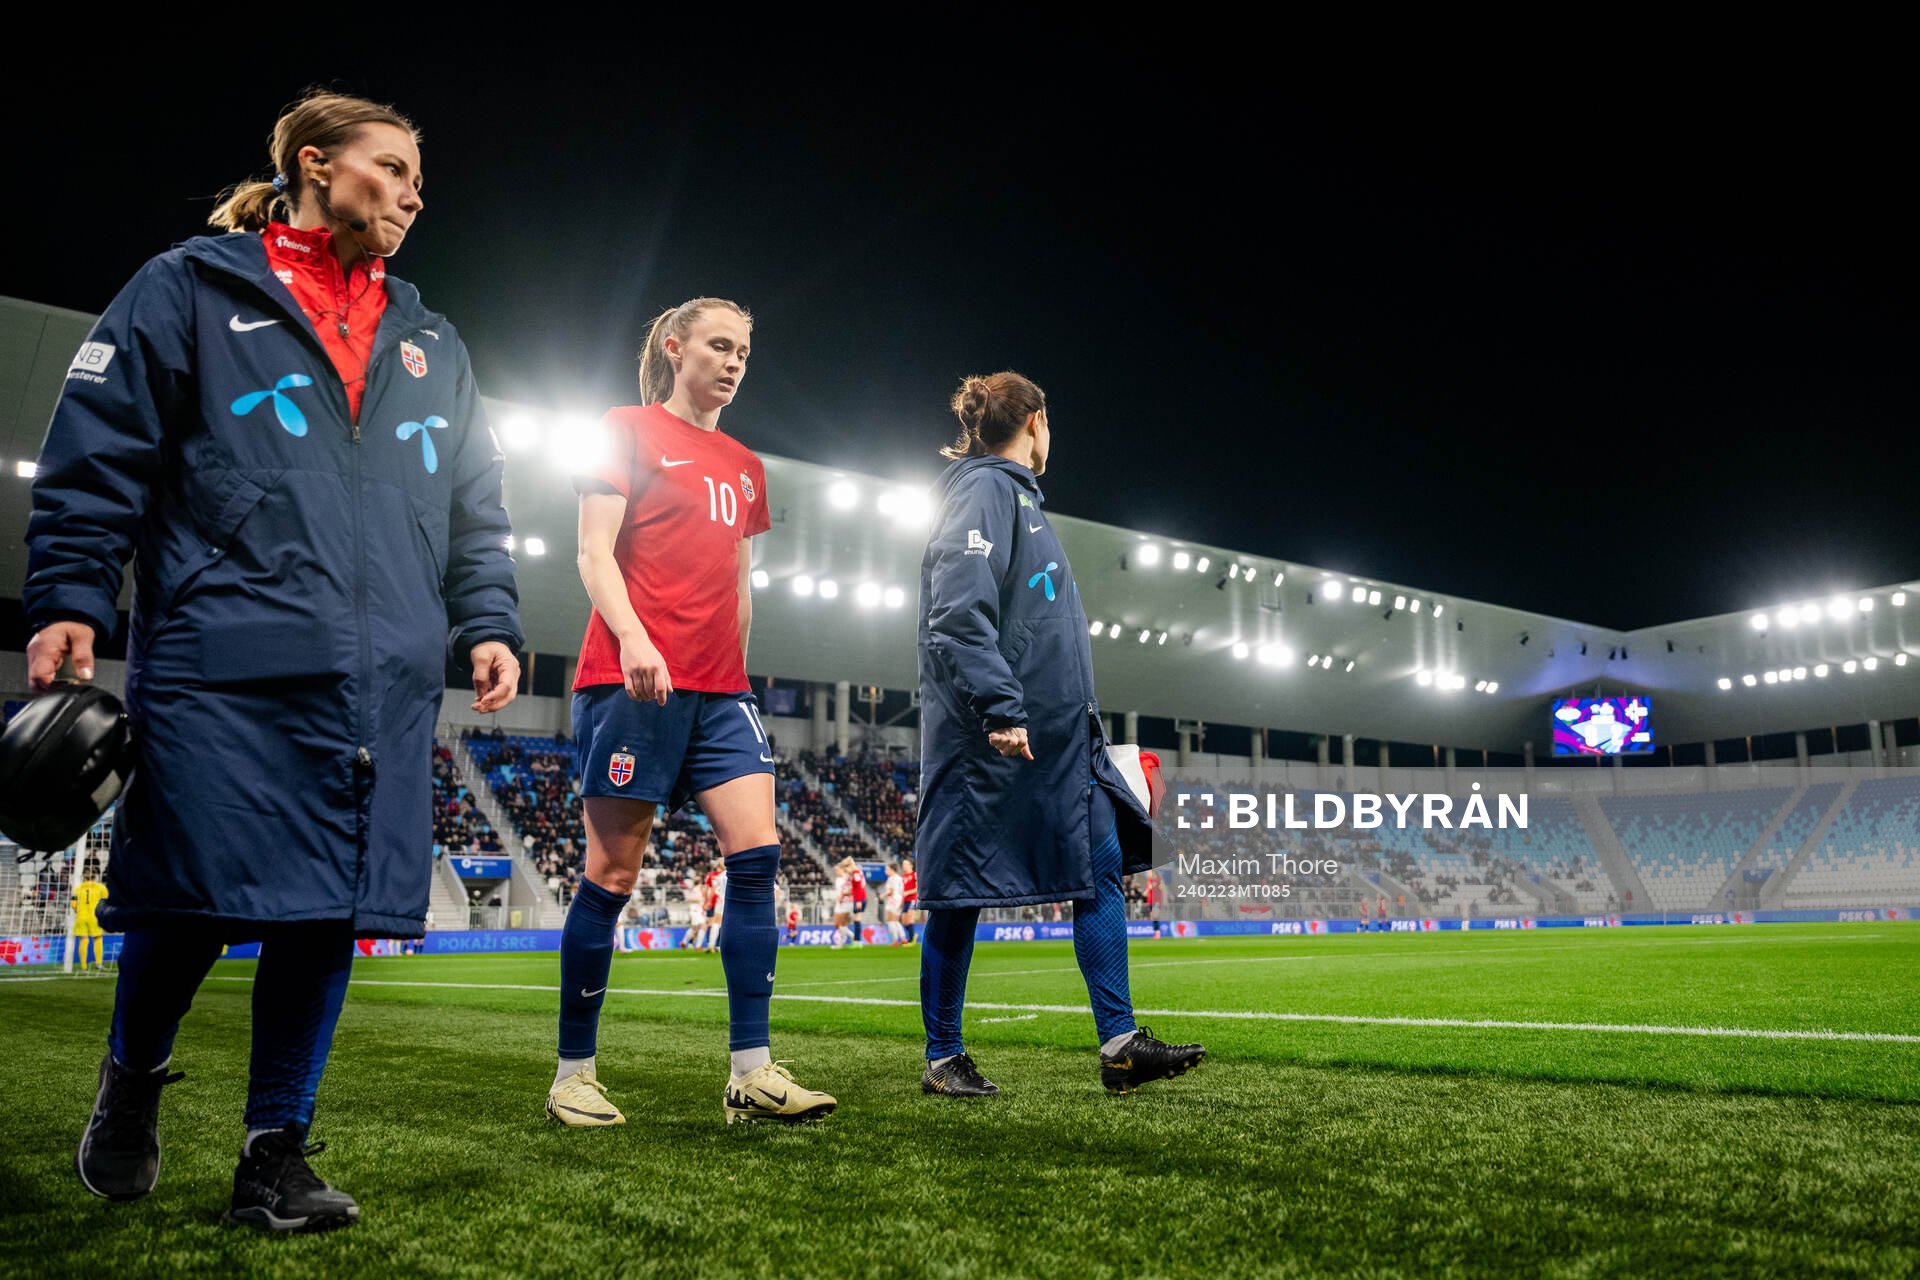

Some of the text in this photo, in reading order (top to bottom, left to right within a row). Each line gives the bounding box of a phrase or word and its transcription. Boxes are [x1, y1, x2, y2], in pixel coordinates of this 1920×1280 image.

[68, 371, 107, 384] esterer
[704, 476, 737, 527] 10
[1838, 912, 1864, 922] PSK
[1272, 923, 1293, 935] PSK
[1391, 920, 1409, 931] PSK
[1494, 919, 1511, 929] PSK
[800, 930, 833, 945] PSK
[994, 926, 1023, 941] PSK
[438, 934, 537, 950] POKAŽI SRCE
